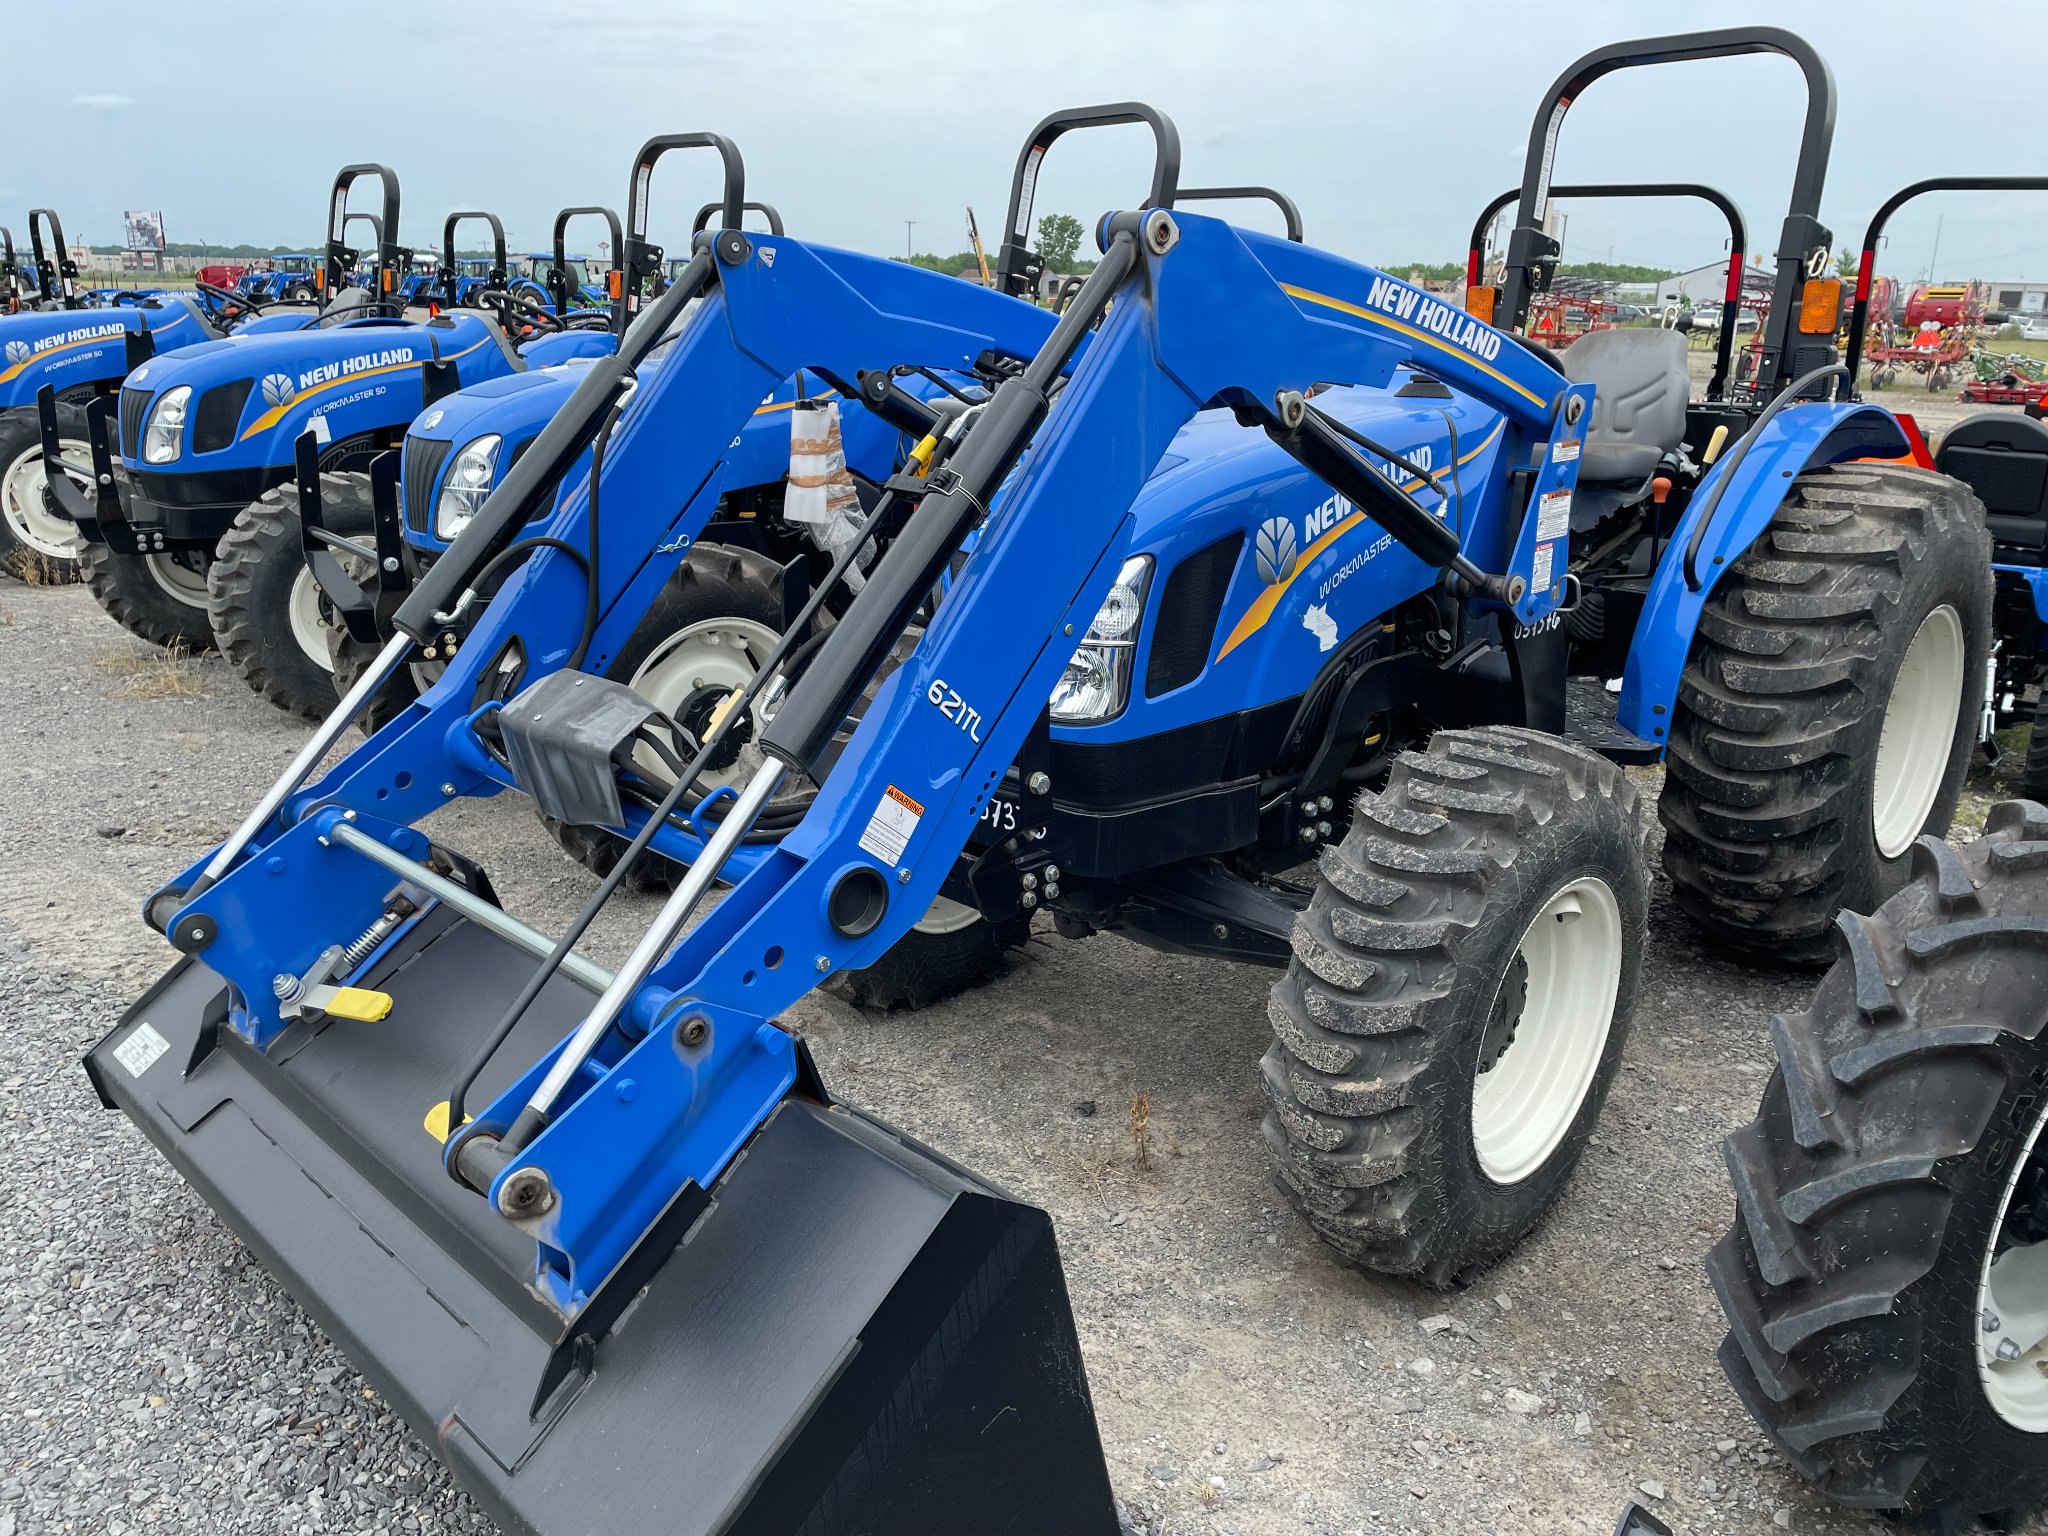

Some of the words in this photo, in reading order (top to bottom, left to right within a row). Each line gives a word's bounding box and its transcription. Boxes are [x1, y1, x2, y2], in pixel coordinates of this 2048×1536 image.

[34, 332, 66, 352] NEW
[67, 322, 125, 343] HOLLAND
[1366, 276, 1421, 320] NEW
[1415, 297, 1501, 362] HOLLAND
[44, 352, 93, 373] WORKMASTER
[93, 350, 103, 359] 50
[299, 361, 340, 389] NEW
[342, 347, 413, 375] HOLLAND
[312, 388, 375, 417] WORKMASTER
[375, 386, 387, 396] 50
[1305, 492, 1354, 544] NEW
[1319, 533, 1392, 600] WORKMASTER
[927, 678, 983, 744] 621TL
[893, 787, 924, 817] WARNING
